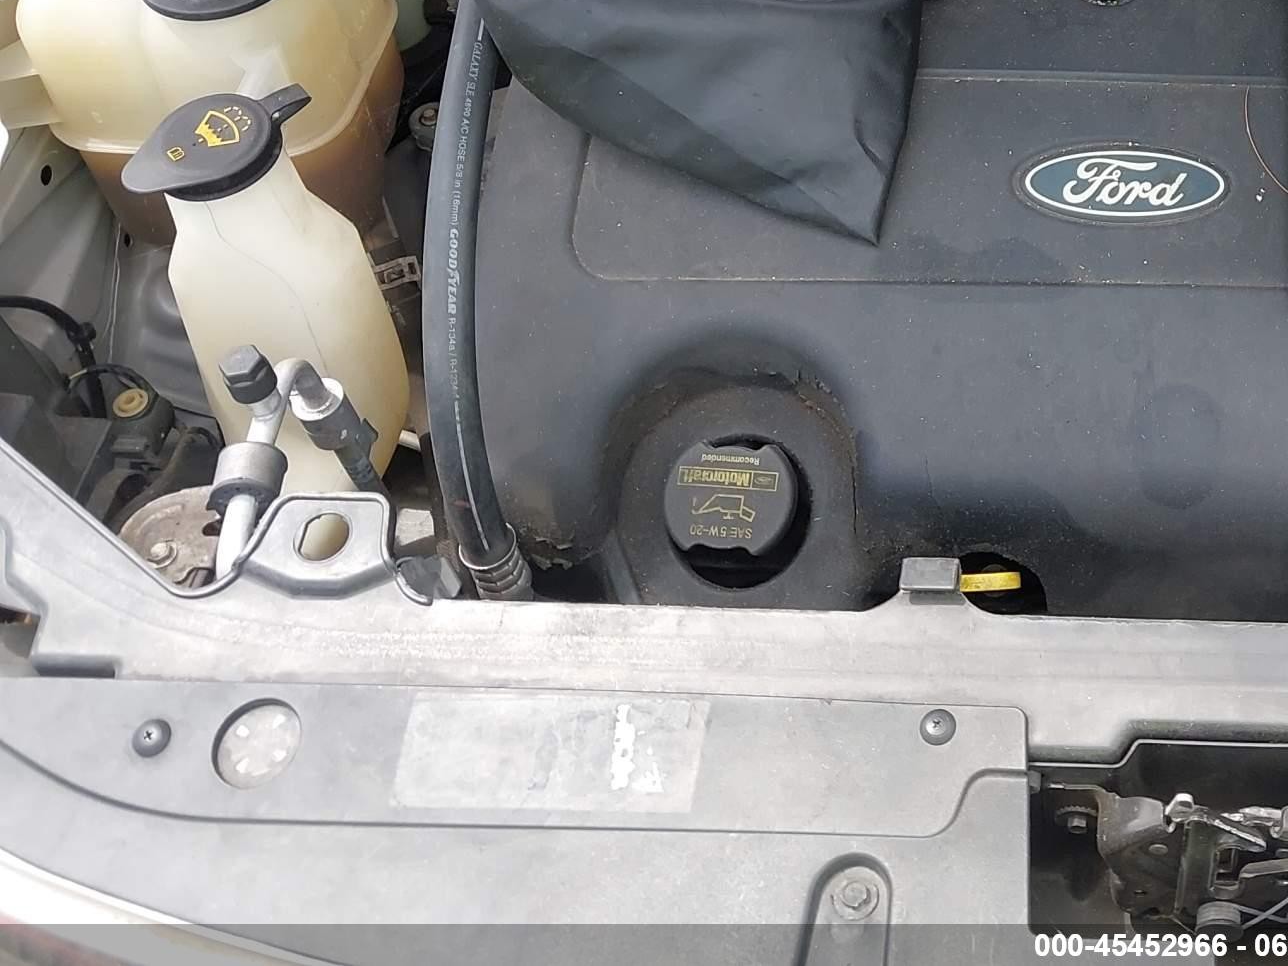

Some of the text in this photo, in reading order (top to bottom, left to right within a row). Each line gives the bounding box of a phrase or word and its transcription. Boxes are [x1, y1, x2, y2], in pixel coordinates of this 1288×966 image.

[457, 136, 468, 162] HOSE
[456, 163, 464, 178] 5/8
[1062, 158, 1188, 206] Ford
[450, 190, 461, 226] (16mm)
[446, 228, 460, 314] GOODYEAR
[701, 453, 760, 466] Recommended
[684, 468, 750, 486] Motorcraft
[732, 526, 753, 539] SAE
